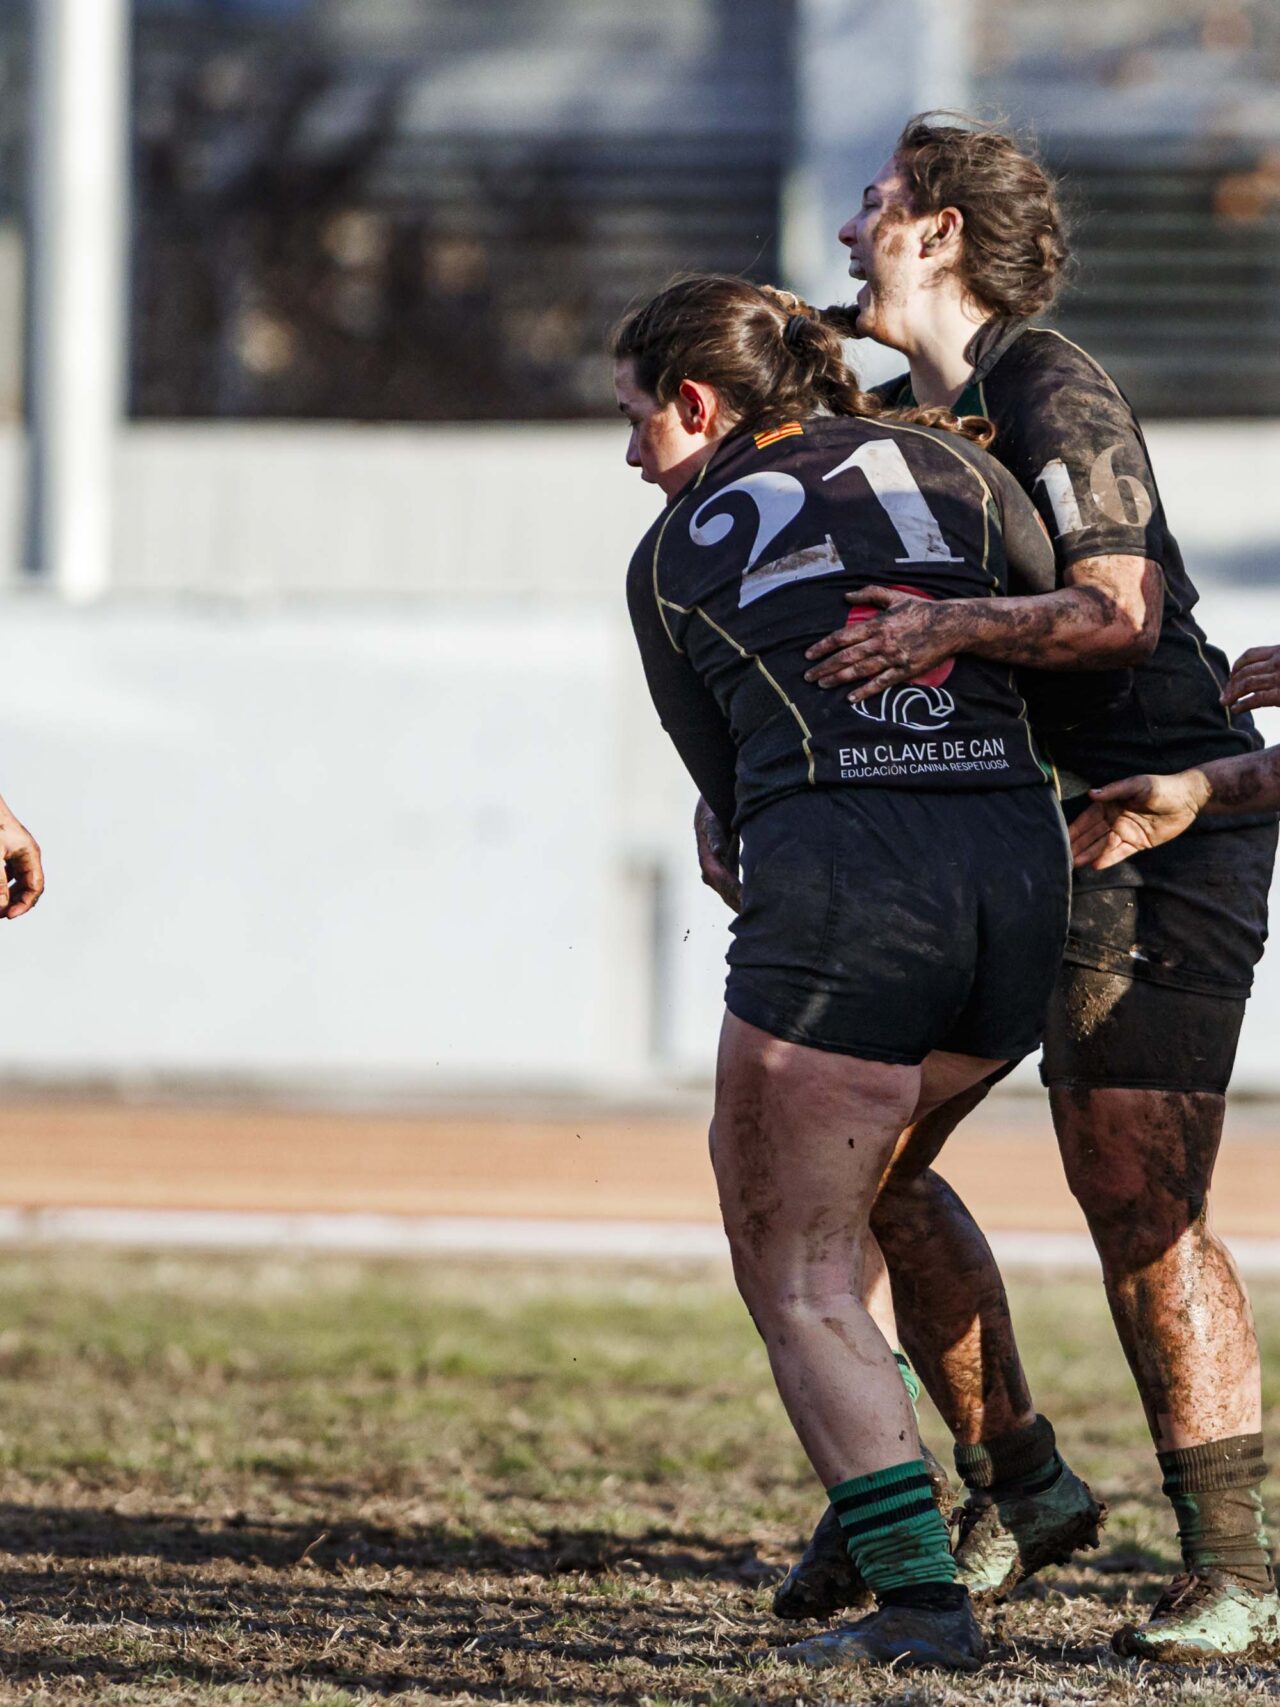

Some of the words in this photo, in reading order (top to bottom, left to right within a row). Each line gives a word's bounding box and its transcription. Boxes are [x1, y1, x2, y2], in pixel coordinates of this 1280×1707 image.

[1031, 443, 1153, 540] 16
[689, 438, 965, 610] 21
[839, 747, 868, 767] EN
[874, 742, 938, 763] CLAVE
[942, 740, 966, 760] DE
[970, 737, 1005, 758] CAN
[909, 761, 949, 775] CANINA
[949, 758, 1011, 773] RESPETUOSA
